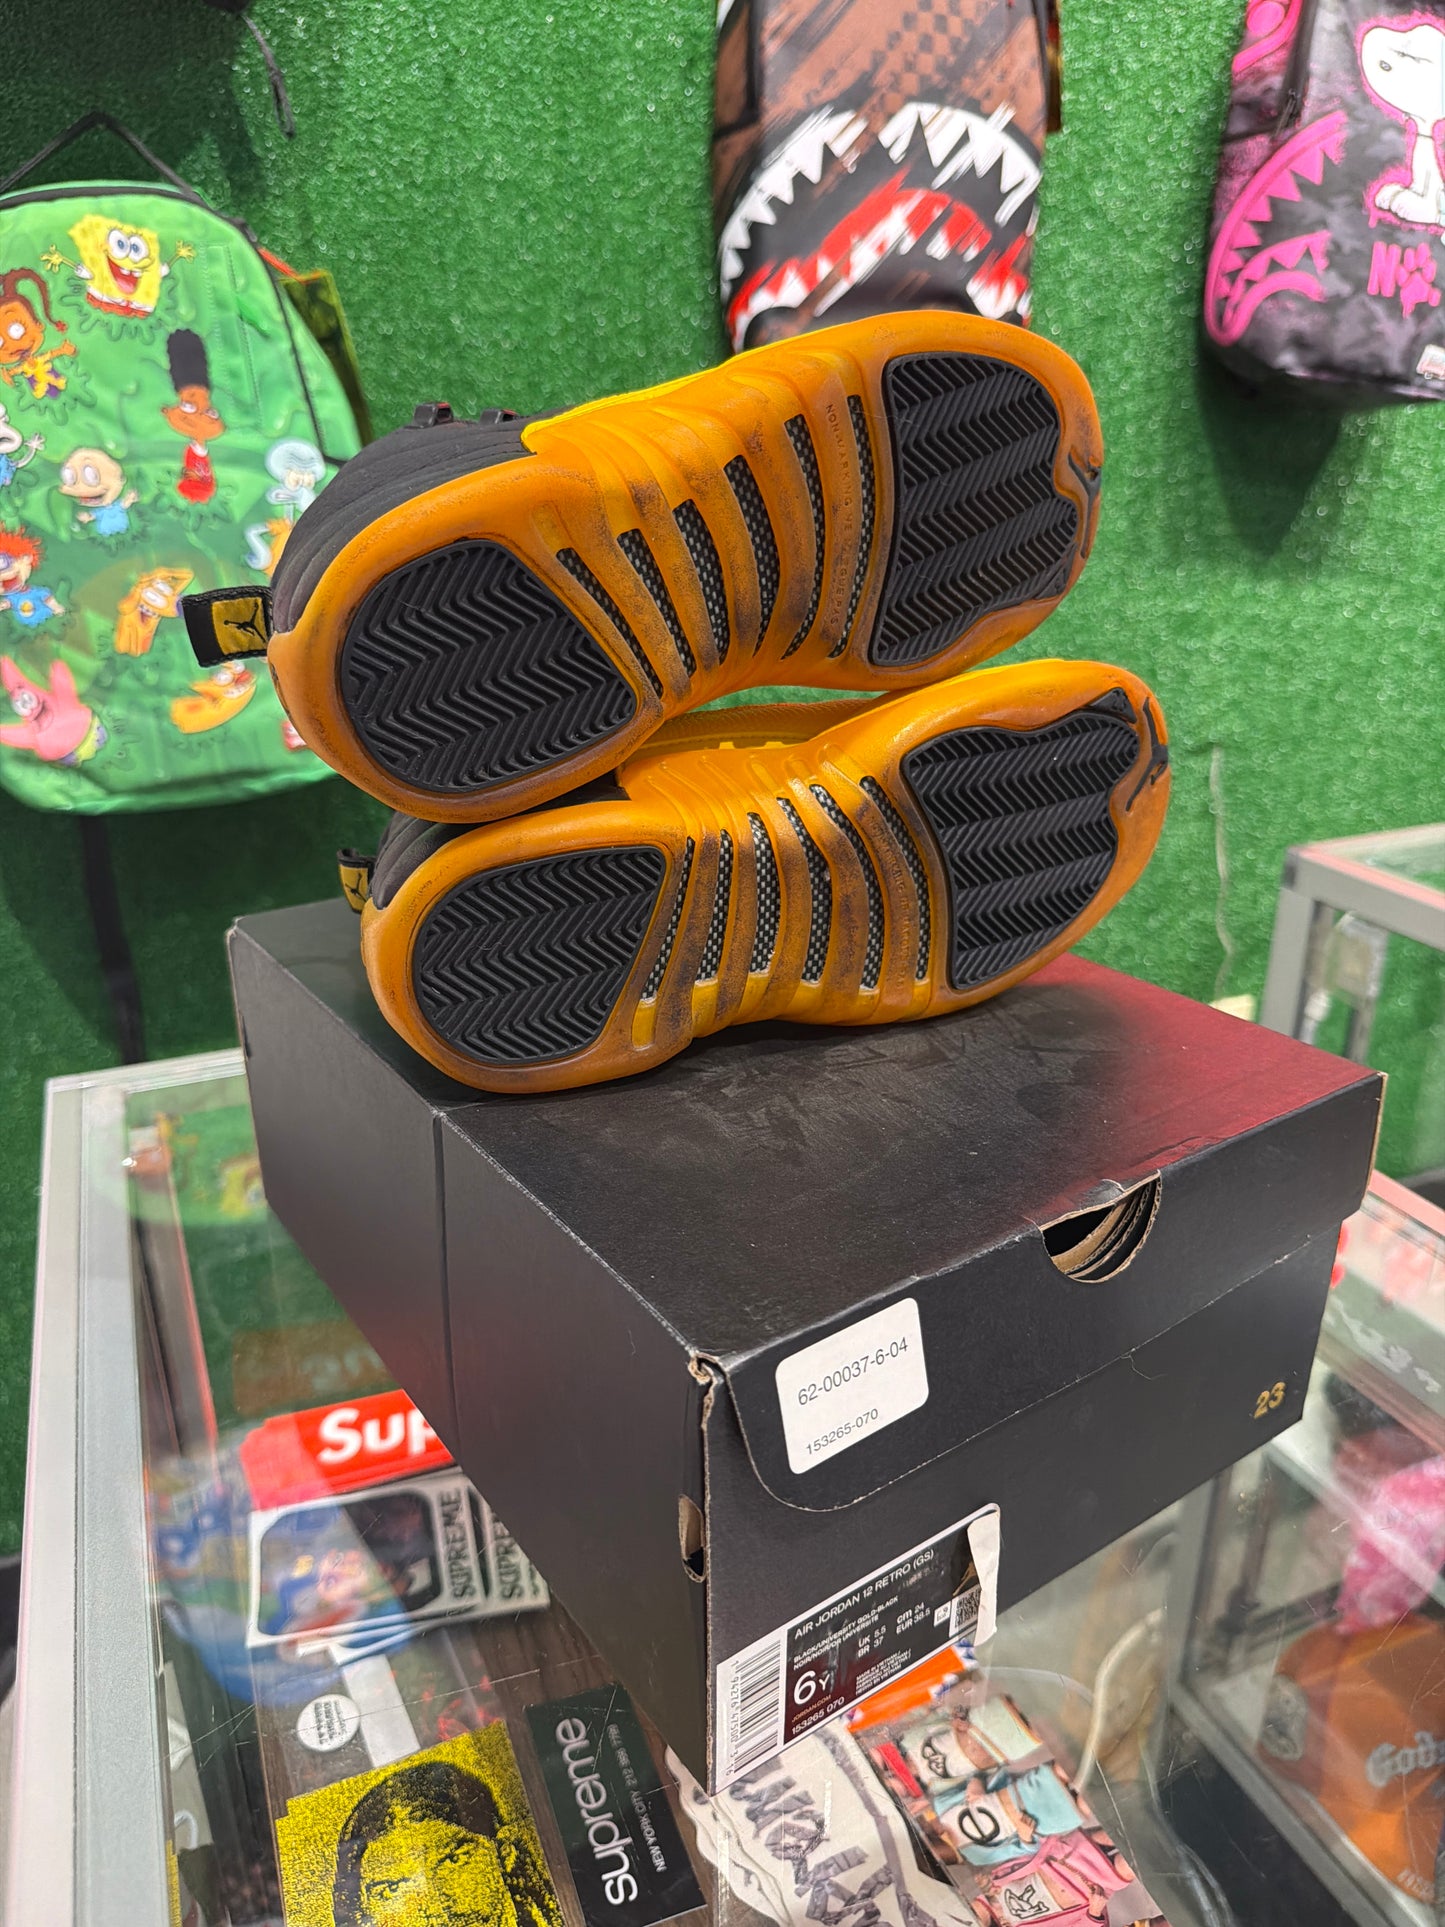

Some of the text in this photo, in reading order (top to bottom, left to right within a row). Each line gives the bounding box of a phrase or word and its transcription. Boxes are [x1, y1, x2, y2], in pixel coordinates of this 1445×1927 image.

[797, 1336, 909, 1406] 62-00037-6-04
[1254, 1381, 1286, 1419] 23
[805, 1408, 879, 1455] 153265-070
[437, 1487, 477, 1600] SUPREME
[794, 1621, 814, 1640] AIR
[815, 1592, 861, 1627] JORDAN
[862, 1585, 874, 1599] 12
[874, 1562, 911, 1593] RETRO
[912, 1548, 935, 1572] (GS)
[896, 1608, 913, 1625] cm
[896, 1618, 913, 1636] EUR
[858, 1634, 871, 1649] UK
[873, 1635, 884, 1649] 37
[791, 1694, 832, 1723] JORDAN.COM
[791, 1696, 845, 1735] 153265 070
[555, 1716, 639, 1906] supreme
[630, 1790, 648, 1815] CITY
[639, 1813, 658, 1847] YORK
[648, 1845, 668, 1873] NEW
